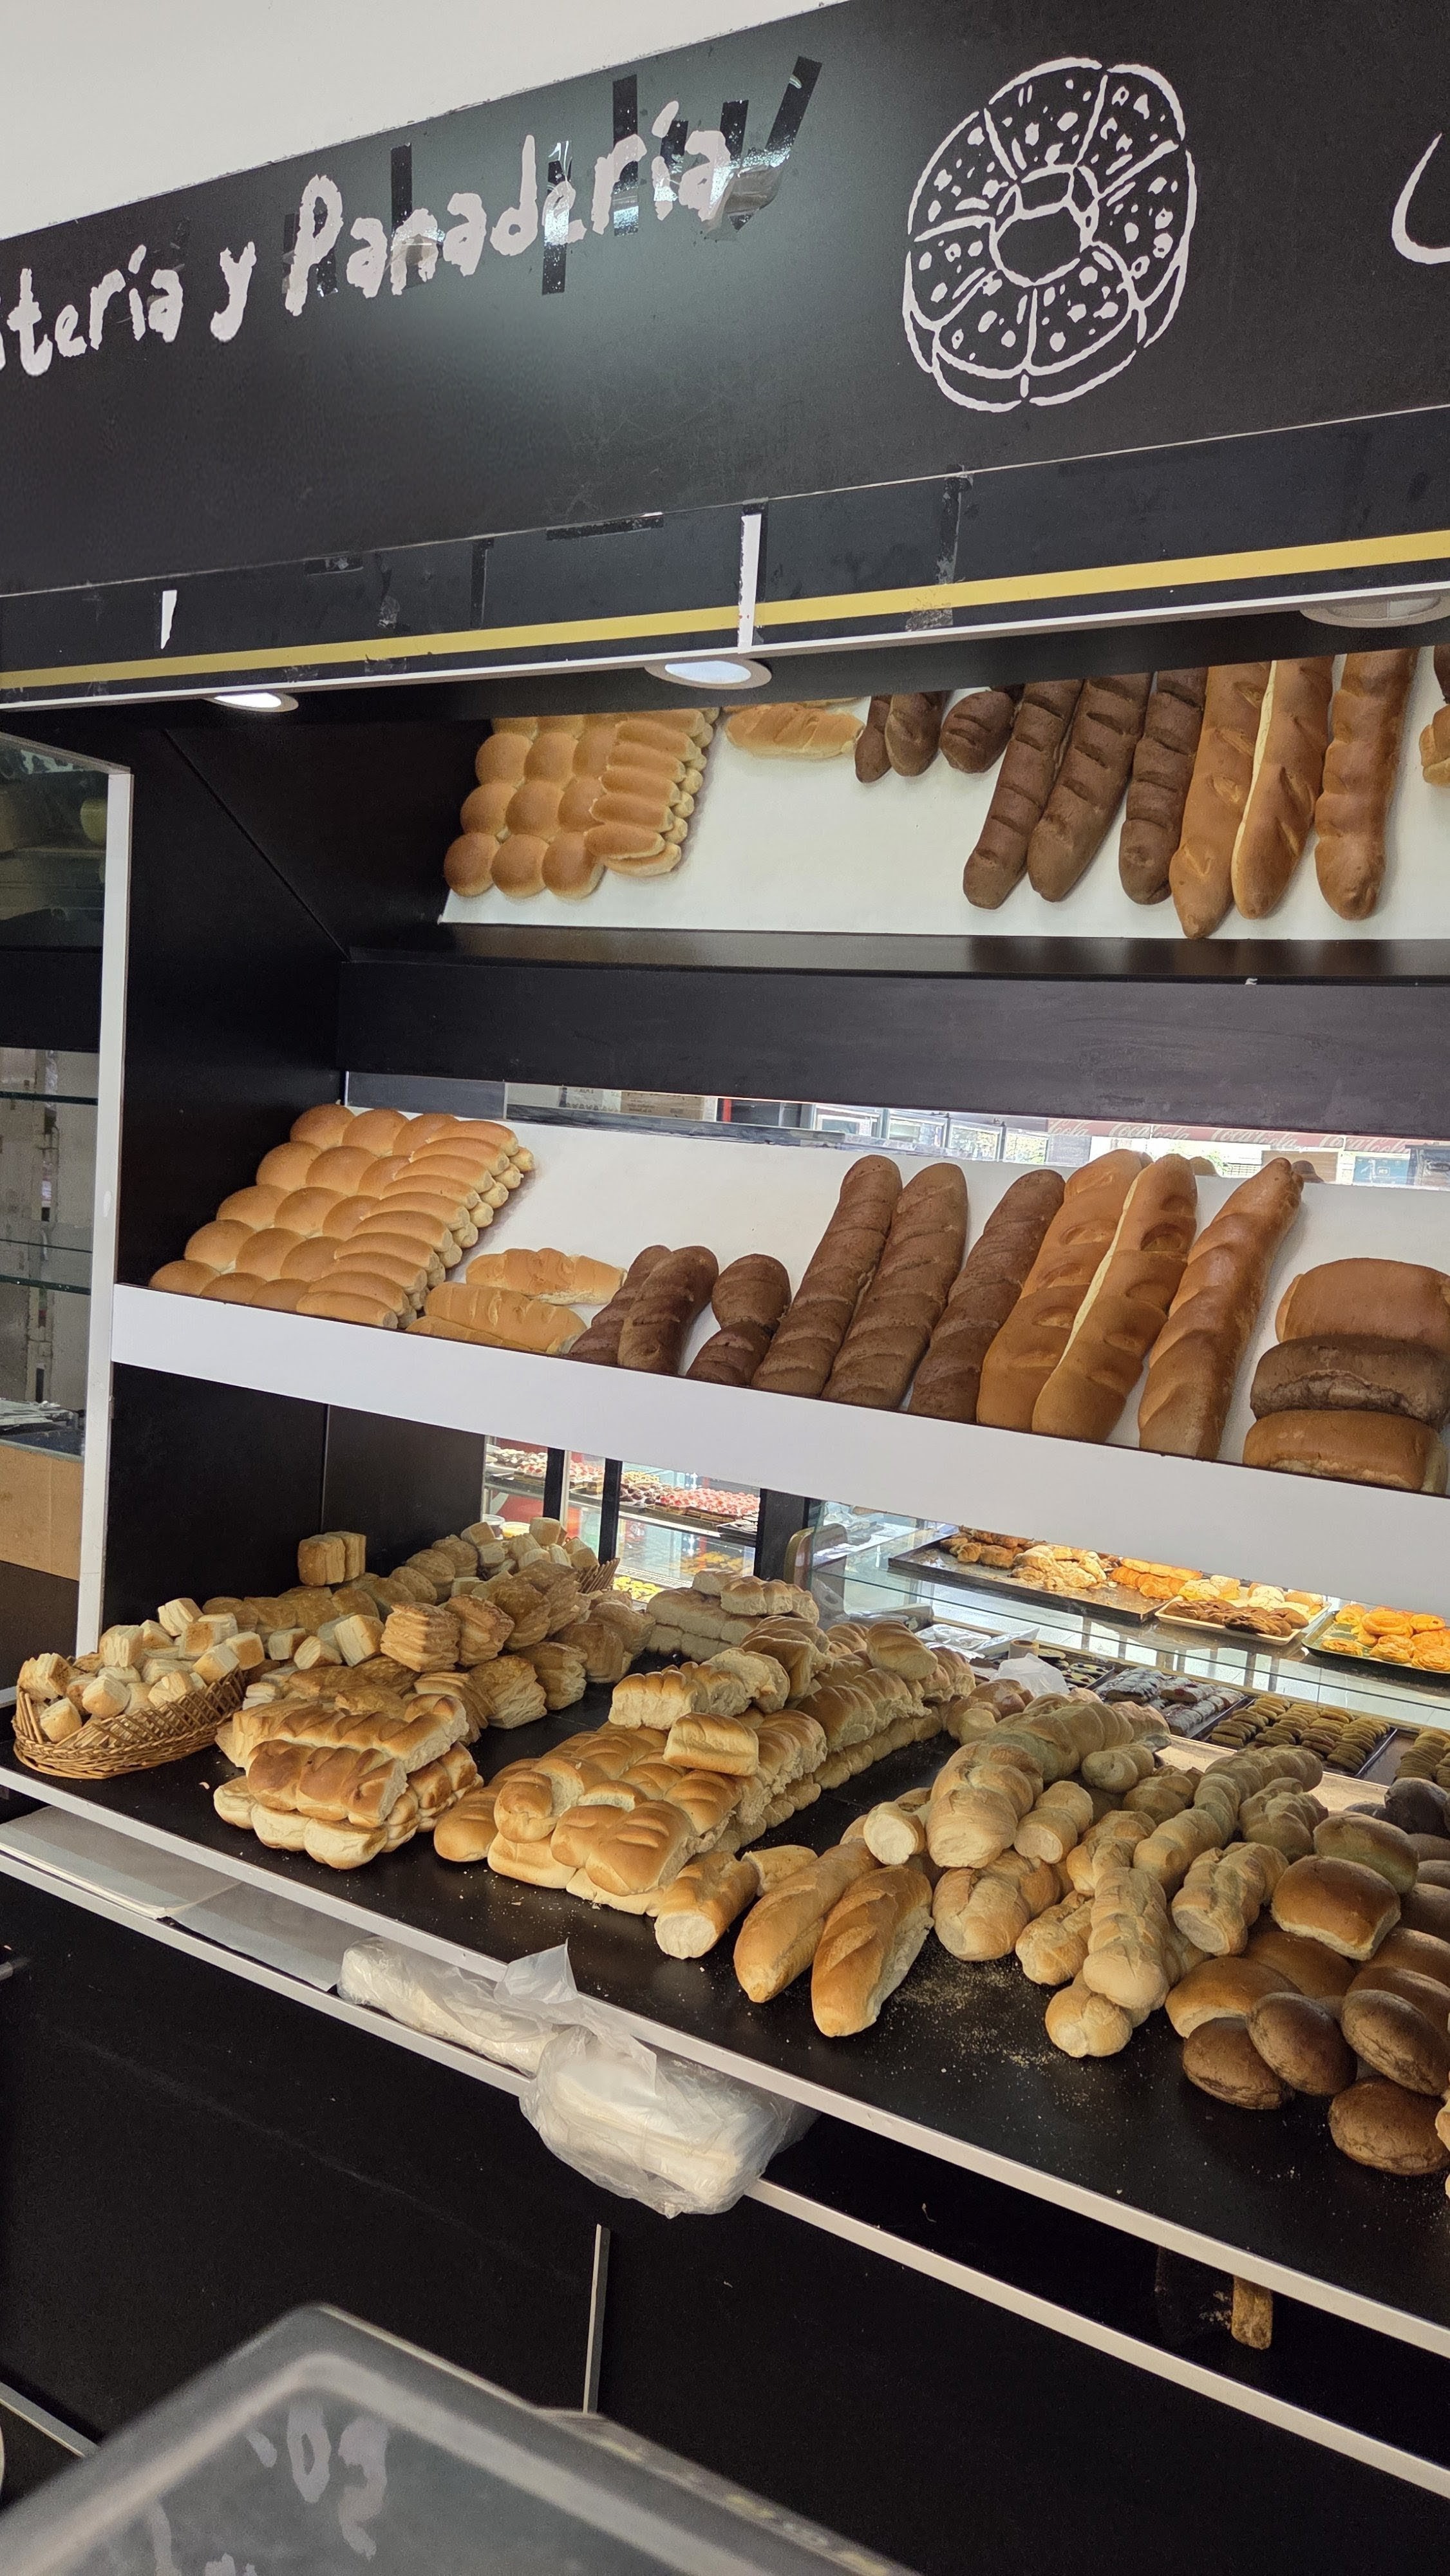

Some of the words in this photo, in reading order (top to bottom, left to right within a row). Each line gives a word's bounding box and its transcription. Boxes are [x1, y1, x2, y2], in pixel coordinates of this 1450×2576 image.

[0, 245, 183, 375] tería
[211, 242, 256, 342] y
[285, 100, 731, 316] Panadería
